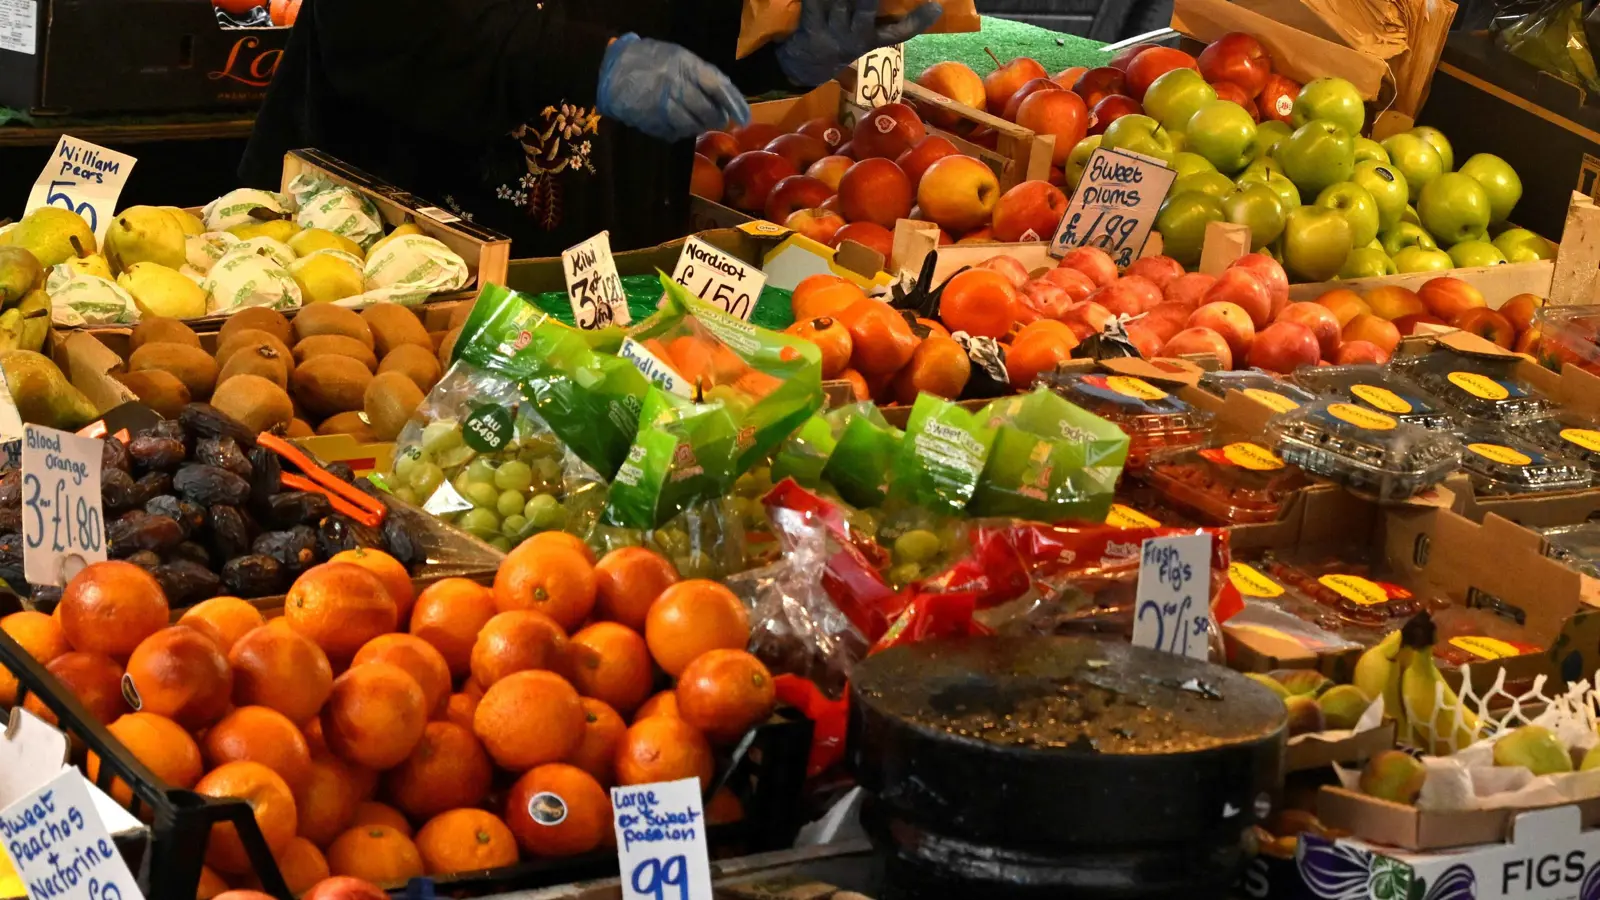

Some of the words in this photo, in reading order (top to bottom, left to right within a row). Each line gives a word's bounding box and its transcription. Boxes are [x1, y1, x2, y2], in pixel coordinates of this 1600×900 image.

[59, 140, 119, 174] William
[1090, 155, 1143, 183] Sweet
[570, 243, 598, 277] Kiwi
[26, 427, 62, 453] Blood
[482, 414, 502, 432] PLU
[24, 473, 45, 549] 3
[52, 478, 101, 552] £1.80
[0, 790, 55, 838] Sweet
[614, 790, 660, 816] Large
[631, 854, 690, 900] 99
[1502, 850, 1586, 894] FIGS
